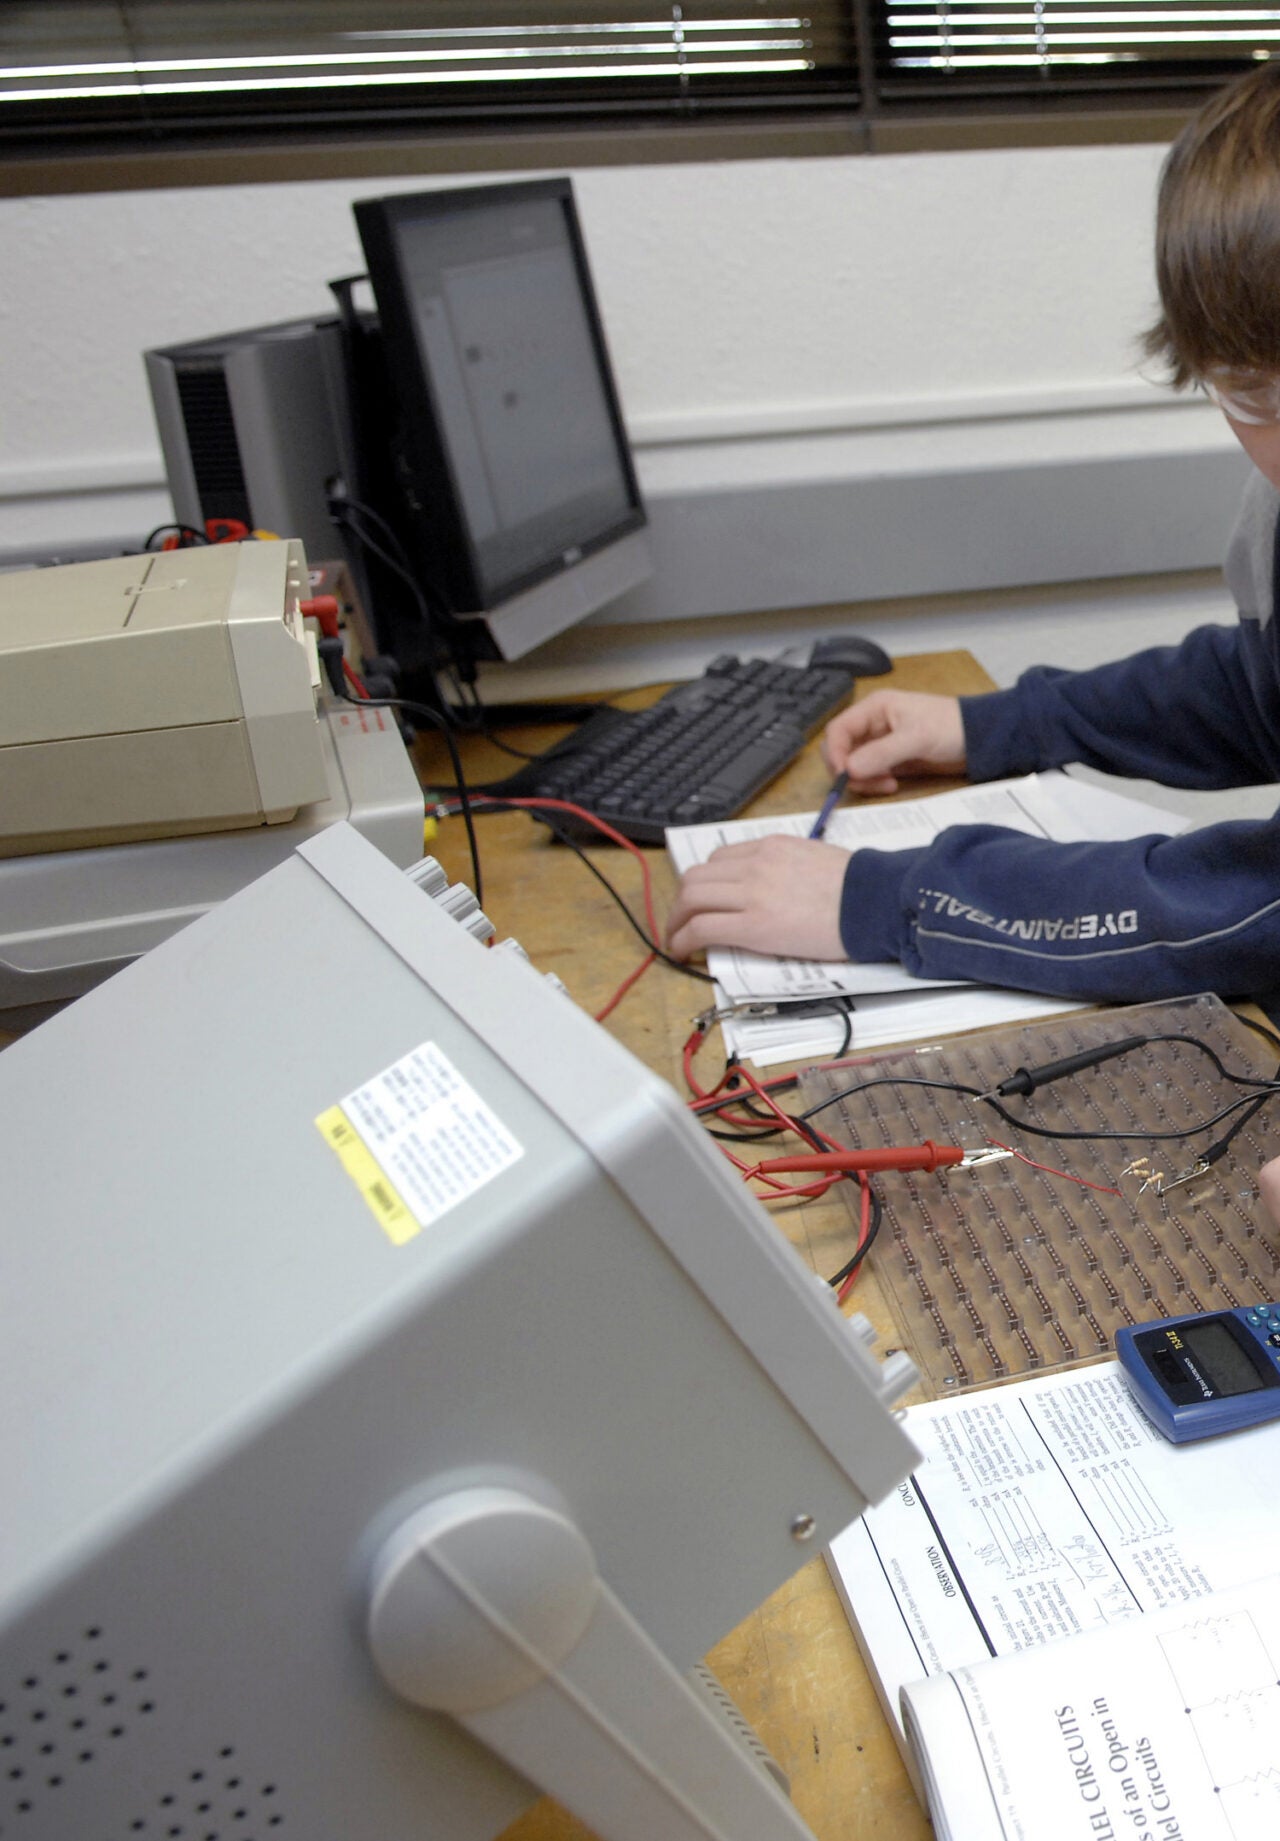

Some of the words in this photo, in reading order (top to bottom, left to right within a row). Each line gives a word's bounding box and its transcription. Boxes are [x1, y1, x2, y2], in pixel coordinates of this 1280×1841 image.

[924, 1544, 956, 1598] OBSERVATION
[1087, 1696, 1109, 1717] in
[1053, 1703, 1102, 1804] CIRCUITS
[1095, 1716, 1135, 1775] Open
[1117, 1776, 1140, 1804] an
[1130, 1735, 1172, 1813] Circuits
[1123, 1804, 1148, 1830] of
